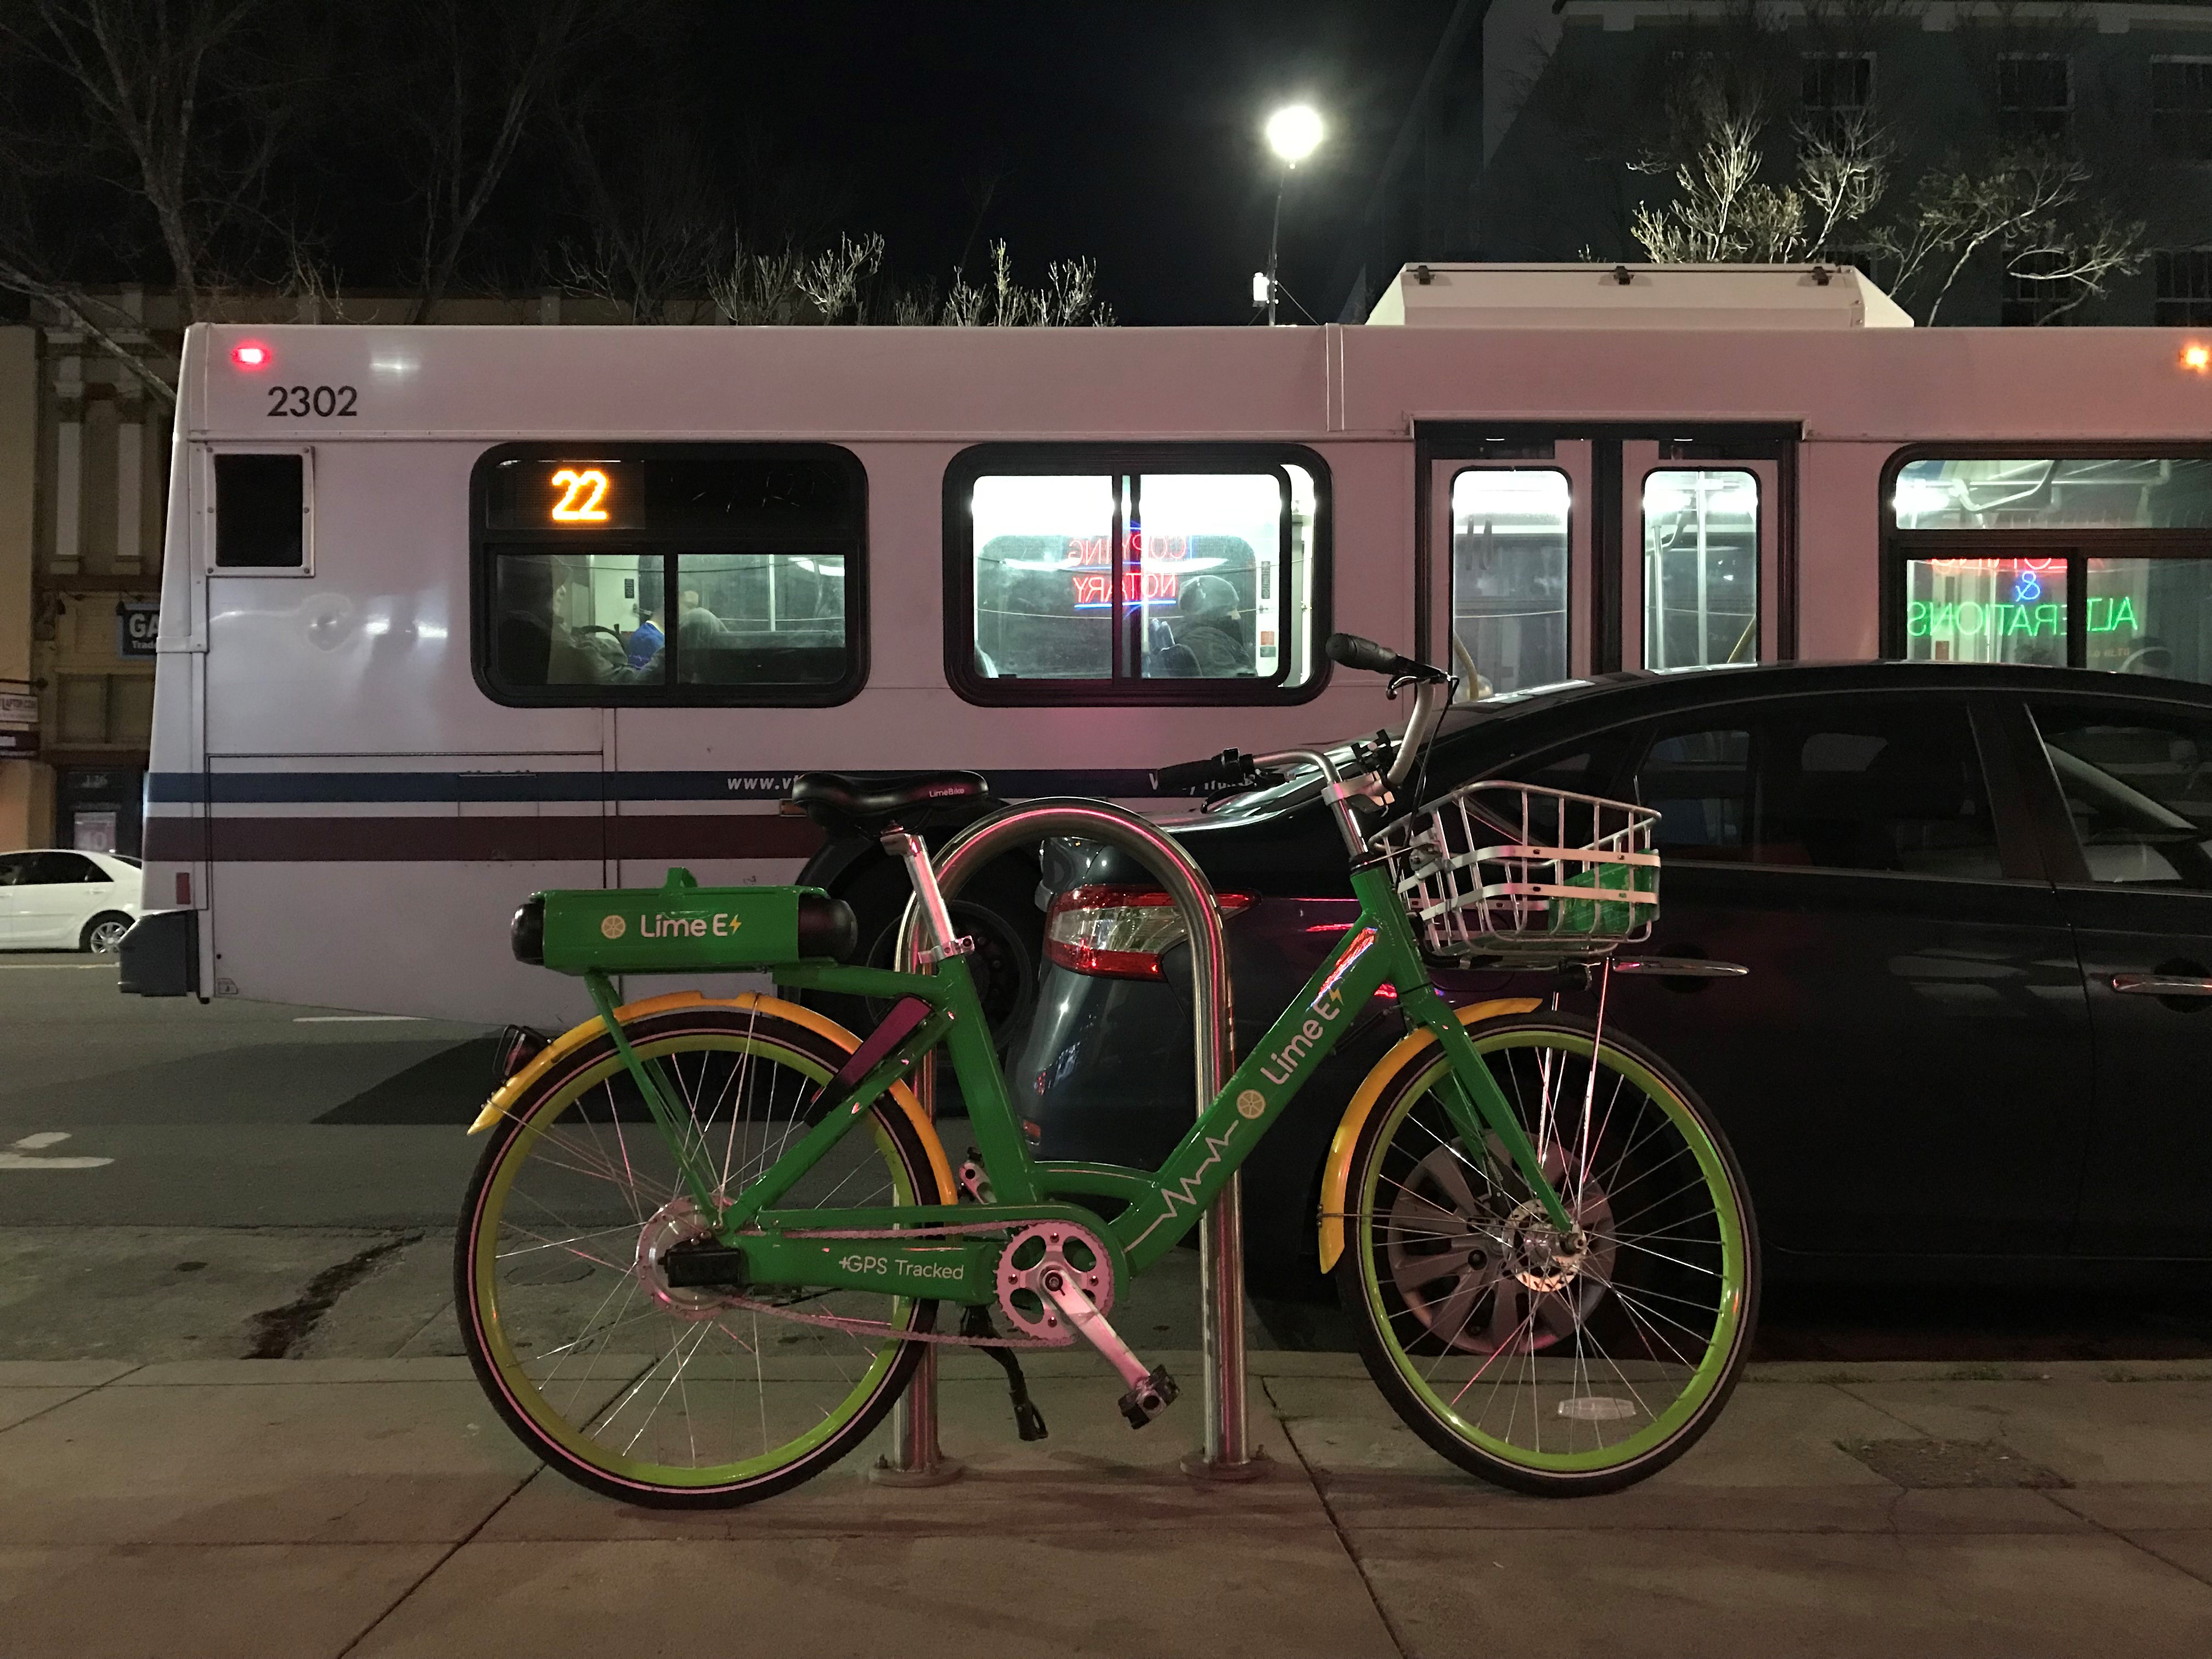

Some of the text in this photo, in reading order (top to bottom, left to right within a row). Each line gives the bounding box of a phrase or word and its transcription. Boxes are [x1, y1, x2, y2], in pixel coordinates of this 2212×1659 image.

[267, 386, 357, 416] 2302
[552, 470, 607, 520] 22
[929, 788, 965, 798] LimeBike
[641, 913, 728, 938] Lime E
[1260, 998, 1340, 1085] Lime E
[895, 1260, 964, 1279] Tracked
